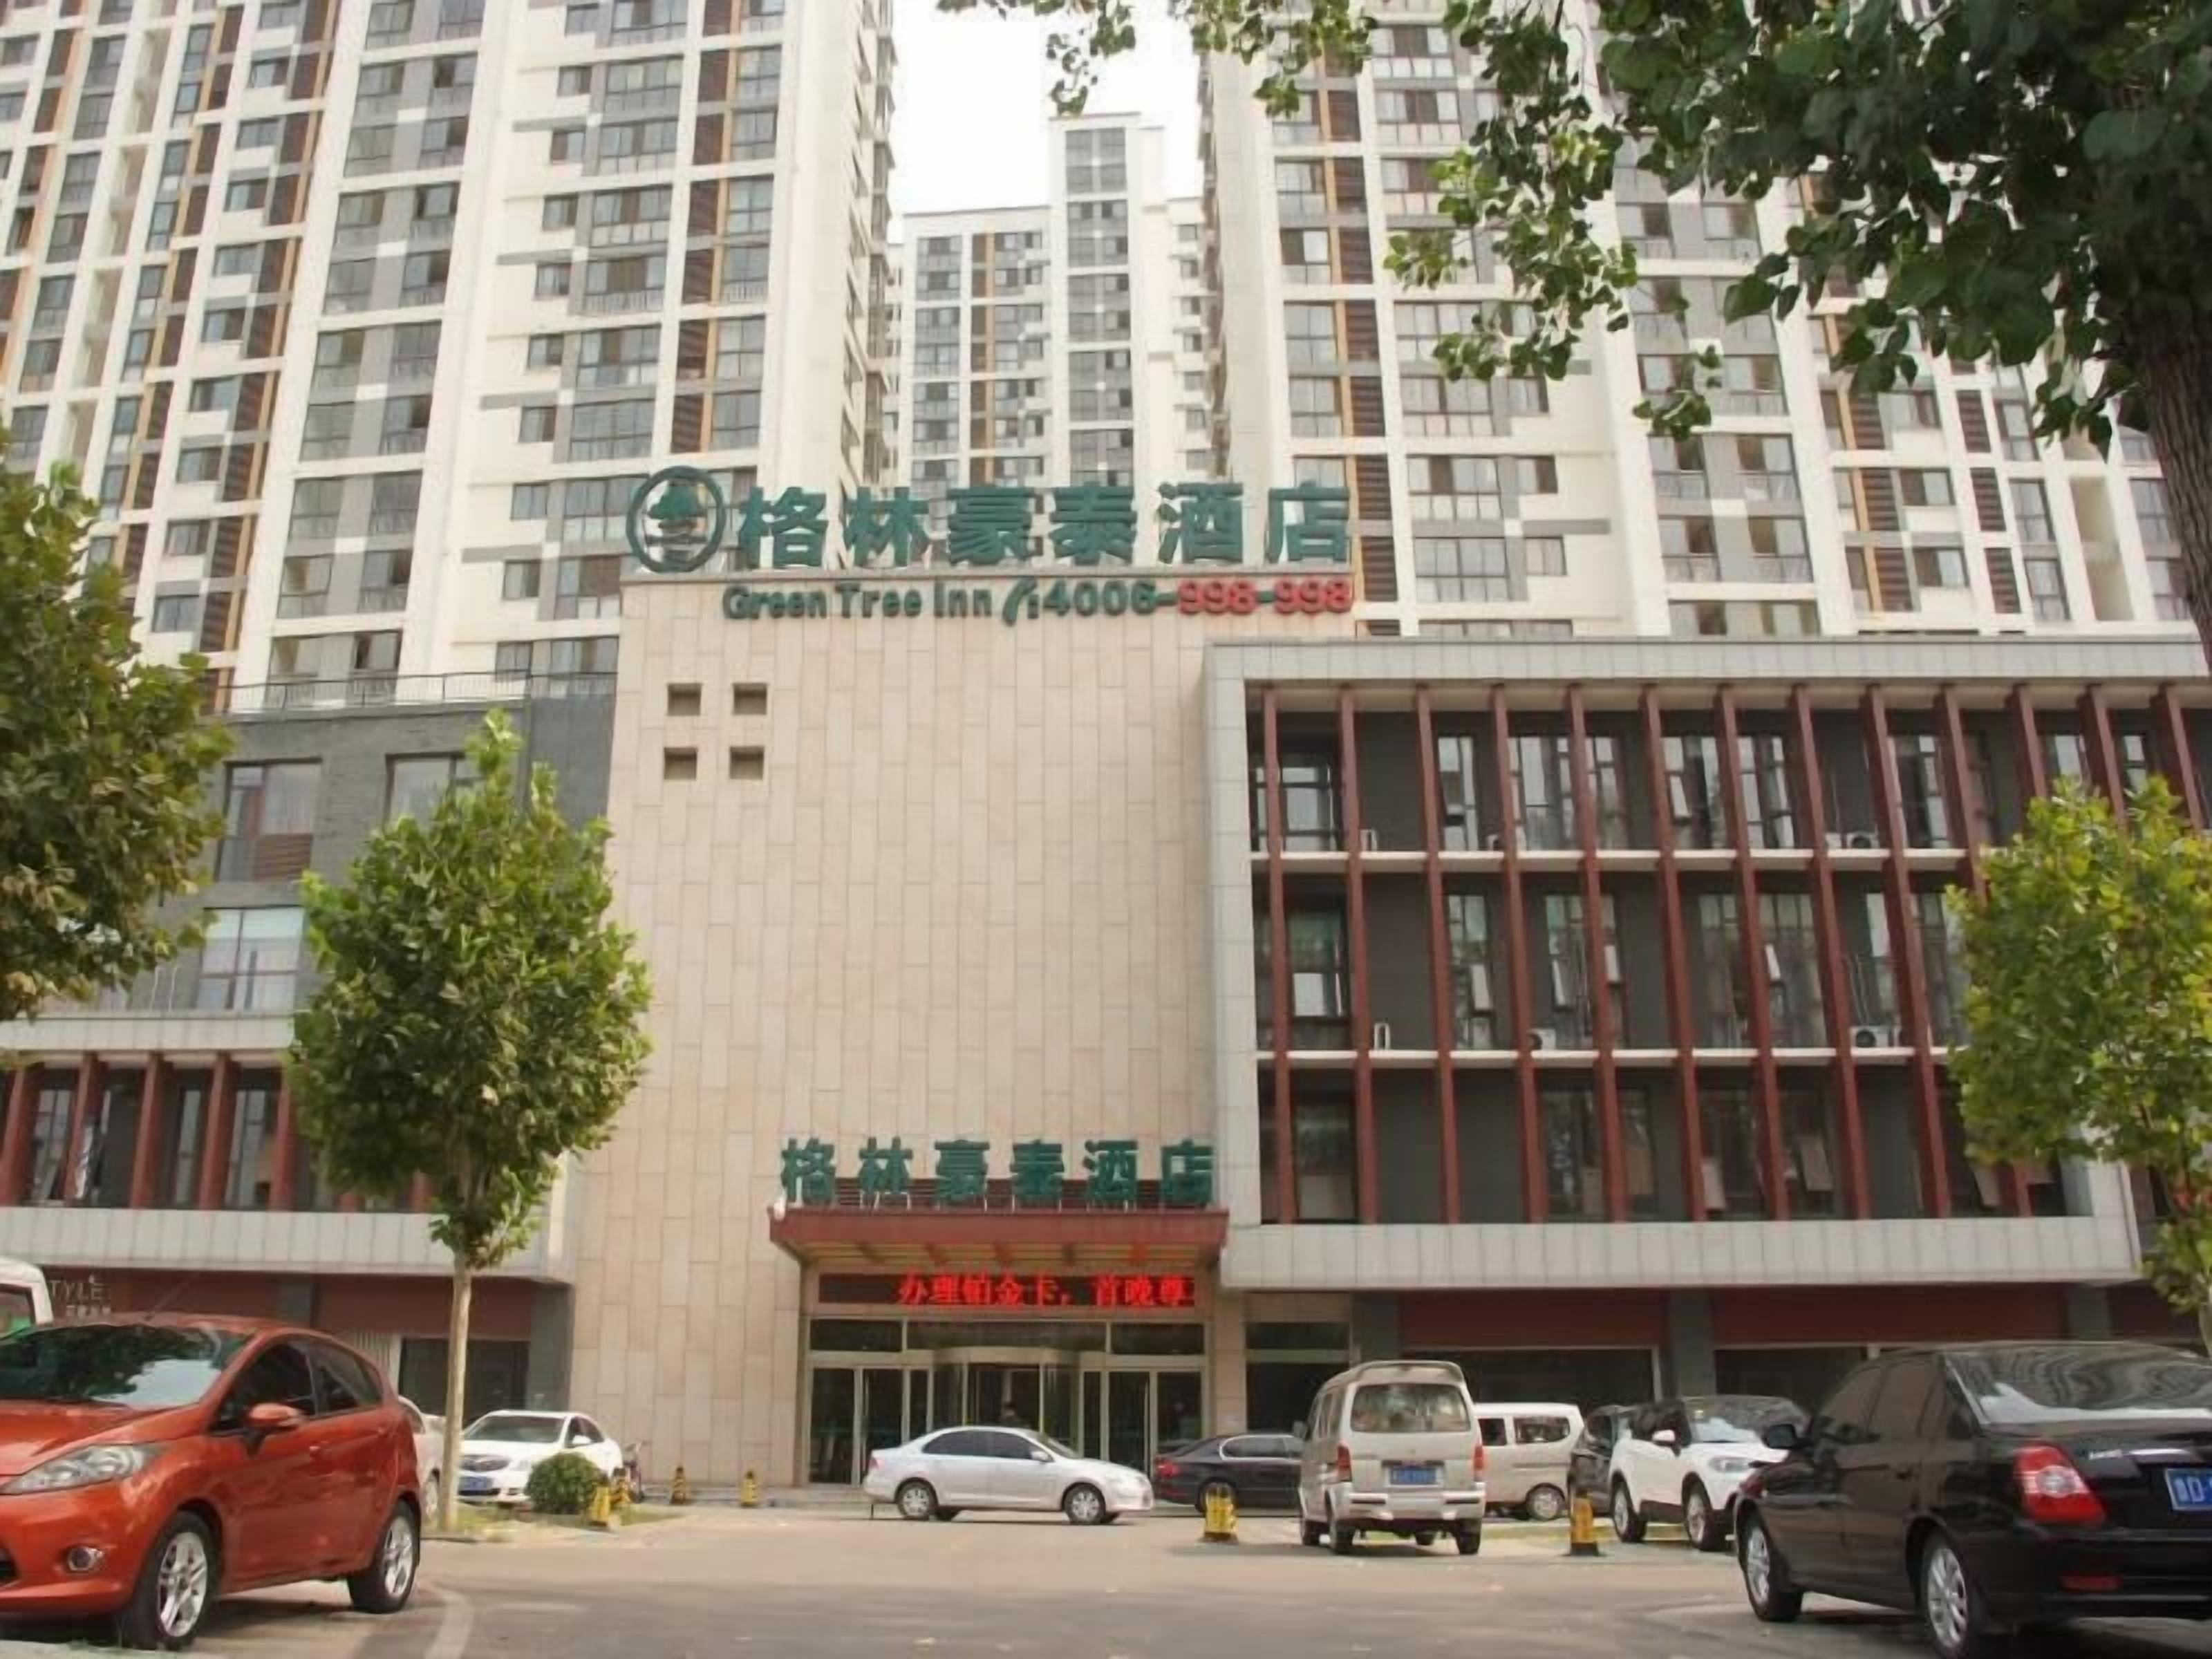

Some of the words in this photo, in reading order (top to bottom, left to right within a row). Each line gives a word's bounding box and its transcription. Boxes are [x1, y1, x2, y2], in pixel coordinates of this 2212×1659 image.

[738, 482, 1350, 568] 格林豪泰酒店
[722, 584, 827, 619] Green
[834, 582, 922, 619] Tree
[933, 581, 993, 618] Inn
[1042, 578, 1353, 616] 4006-998-998
[780, 1136, 1214, 1204] 格林豪泰酒店
